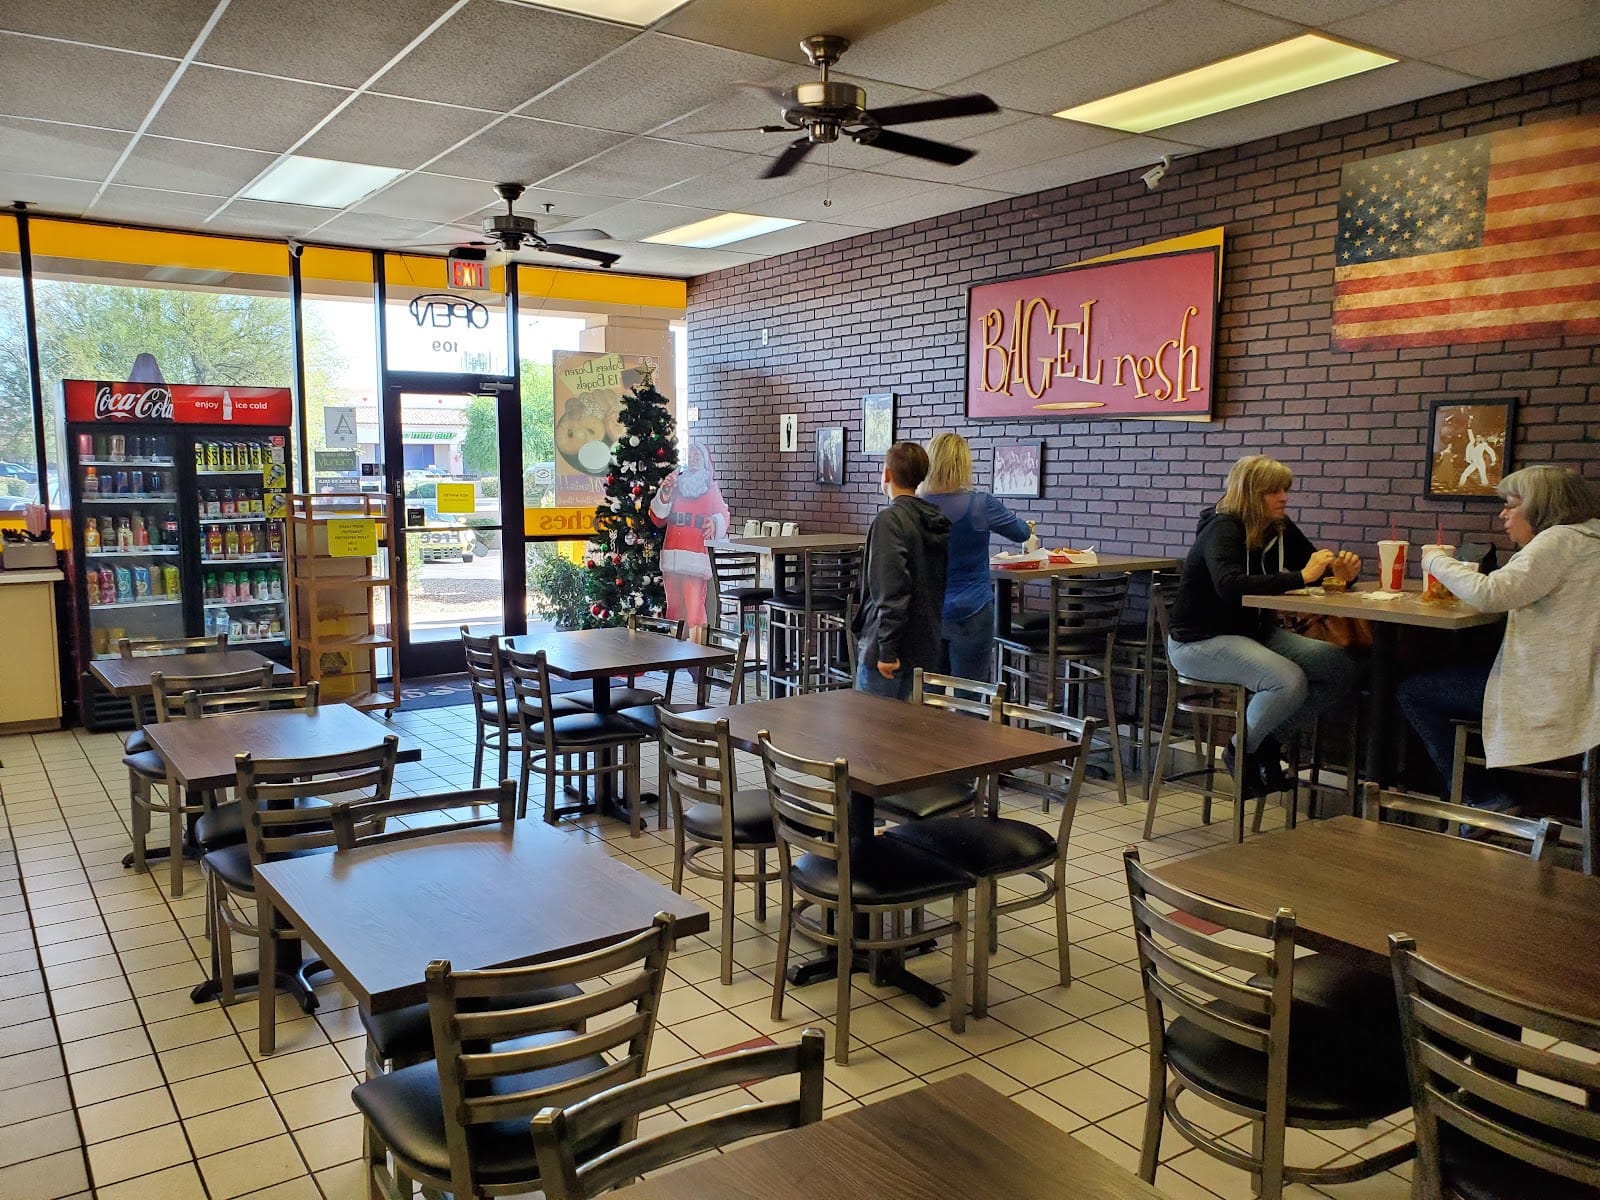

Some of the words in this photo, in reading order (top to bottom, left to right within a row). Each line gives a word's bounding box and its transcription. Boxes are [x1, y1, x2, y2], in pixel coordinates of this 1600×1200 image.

[453, 261, 484, 288] EXIT
[977, 297, 1103, 399] BAGEL
[1112, 305, 1203, 403] nosh
[94, 387, 174, 419] Coca-Cola
[194, 401, 219, 410] enjoy
[235, 401, 247, 410] ice
[249, 401, 268, 410] cold
